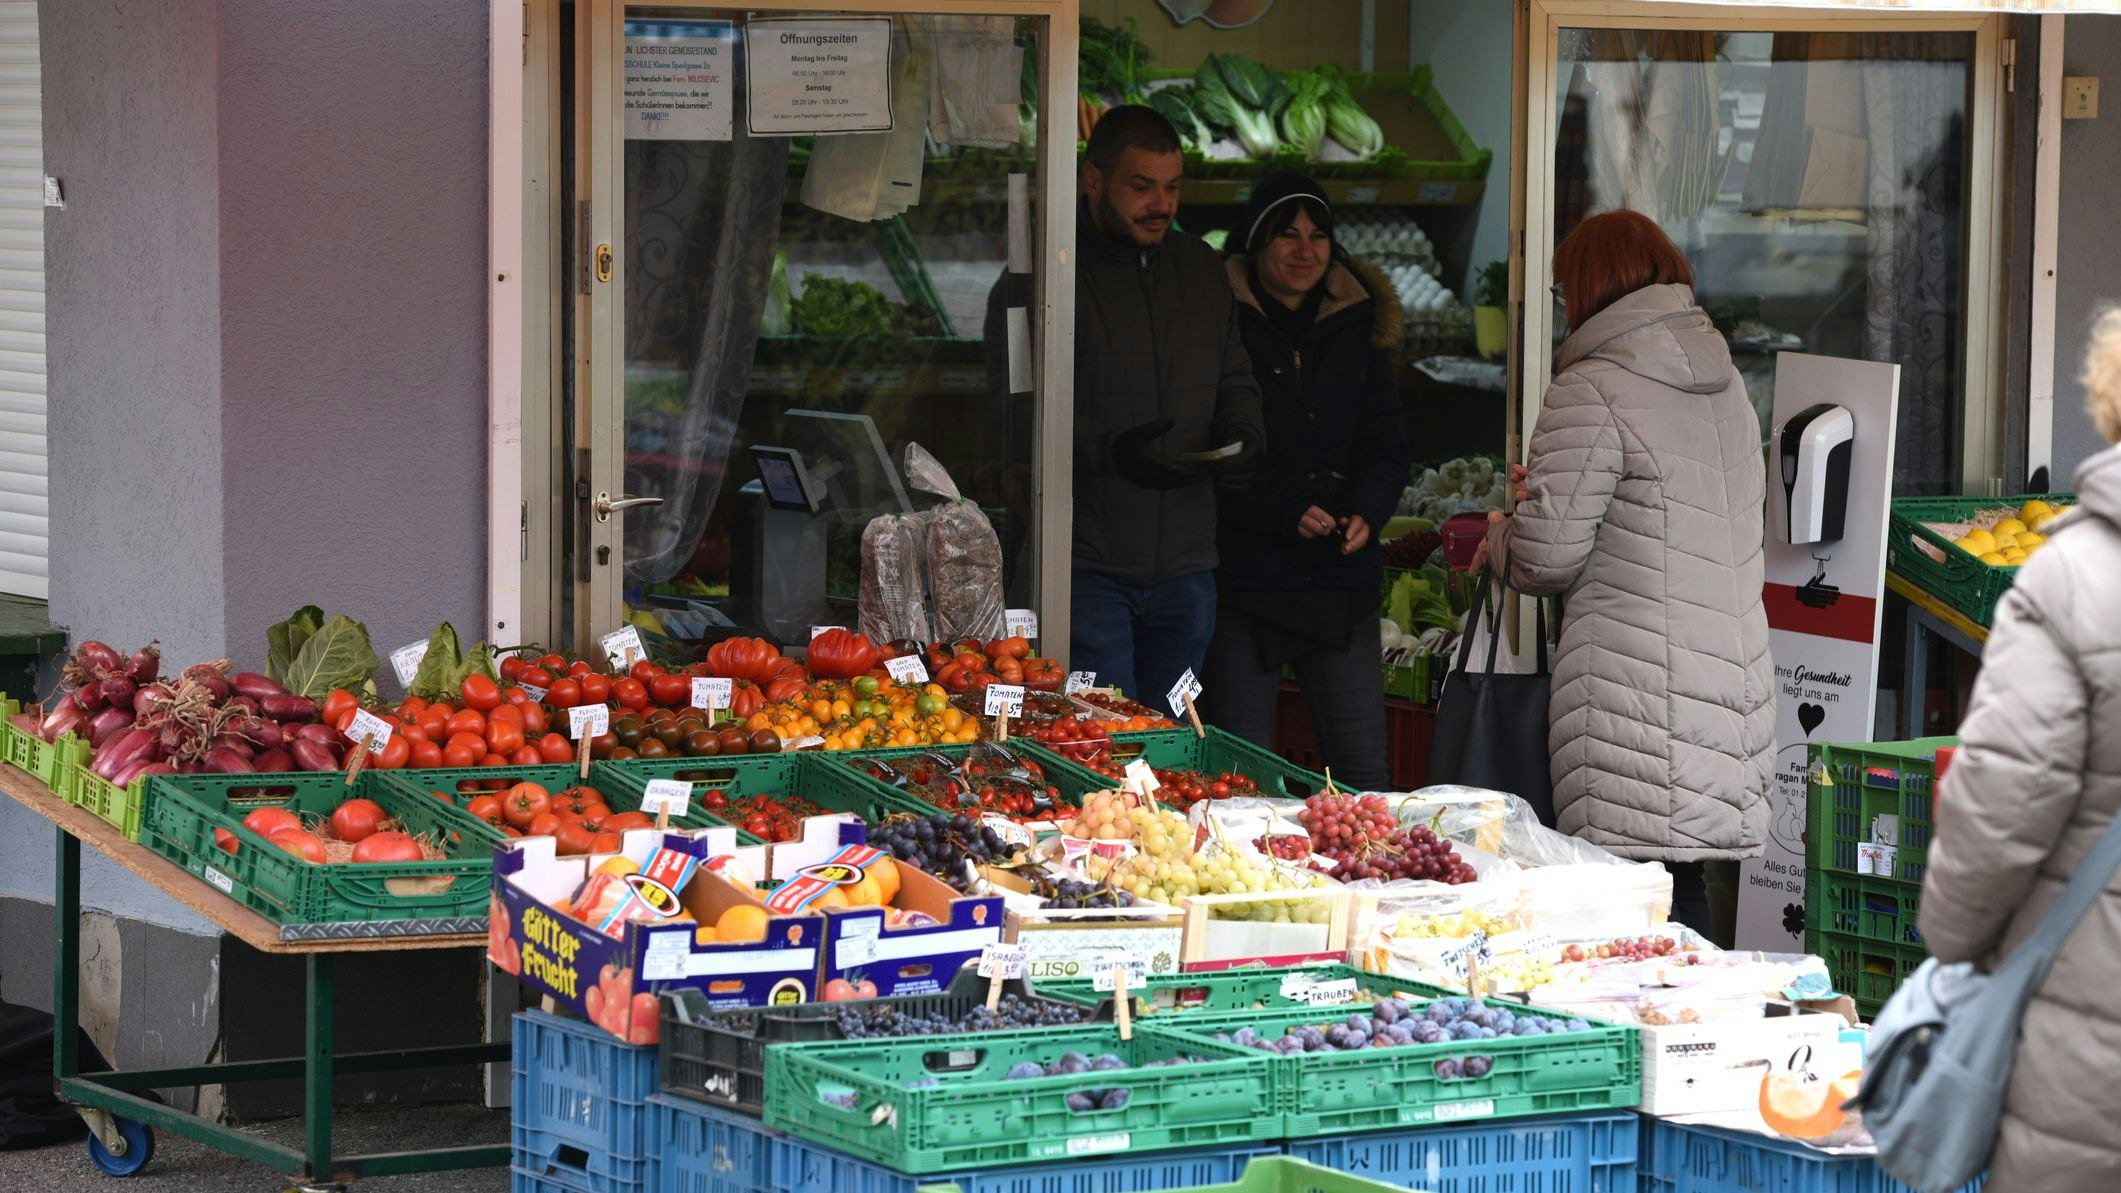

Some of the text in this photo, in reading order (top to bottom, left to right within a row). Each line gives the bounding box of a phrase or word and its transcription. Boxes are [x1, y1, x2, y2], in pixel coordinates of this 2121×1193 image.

[780, 33, 858, 46] Öffnungszeiten
[668, 46, 718, 56] GEMÜSESTAND
[653, 60, 671, 69] Kleine
[791, 54, 848, 64] Montag bis Freitag
[690, 89, 700, 97] die
[805, 84, 832, 92] Samstag
[1775, 664, 1852, 688] Ihre Gesundheit
[990, 689, 1023, 700] TOMATEN
[1783, 682, 1840, 702] liegt uns am
[1791, 788, 1799, 797] 01
[1801, 790, 1806, 799] 2
[1763, 859, 1787, 874] Alles
[1749, 873, 1801, 894] bleiben Sie
[521, 906, 582, 964] Götter
[521, 941, 578, 1000] Frucht
[1029, 961, 1079, 977] LISO
